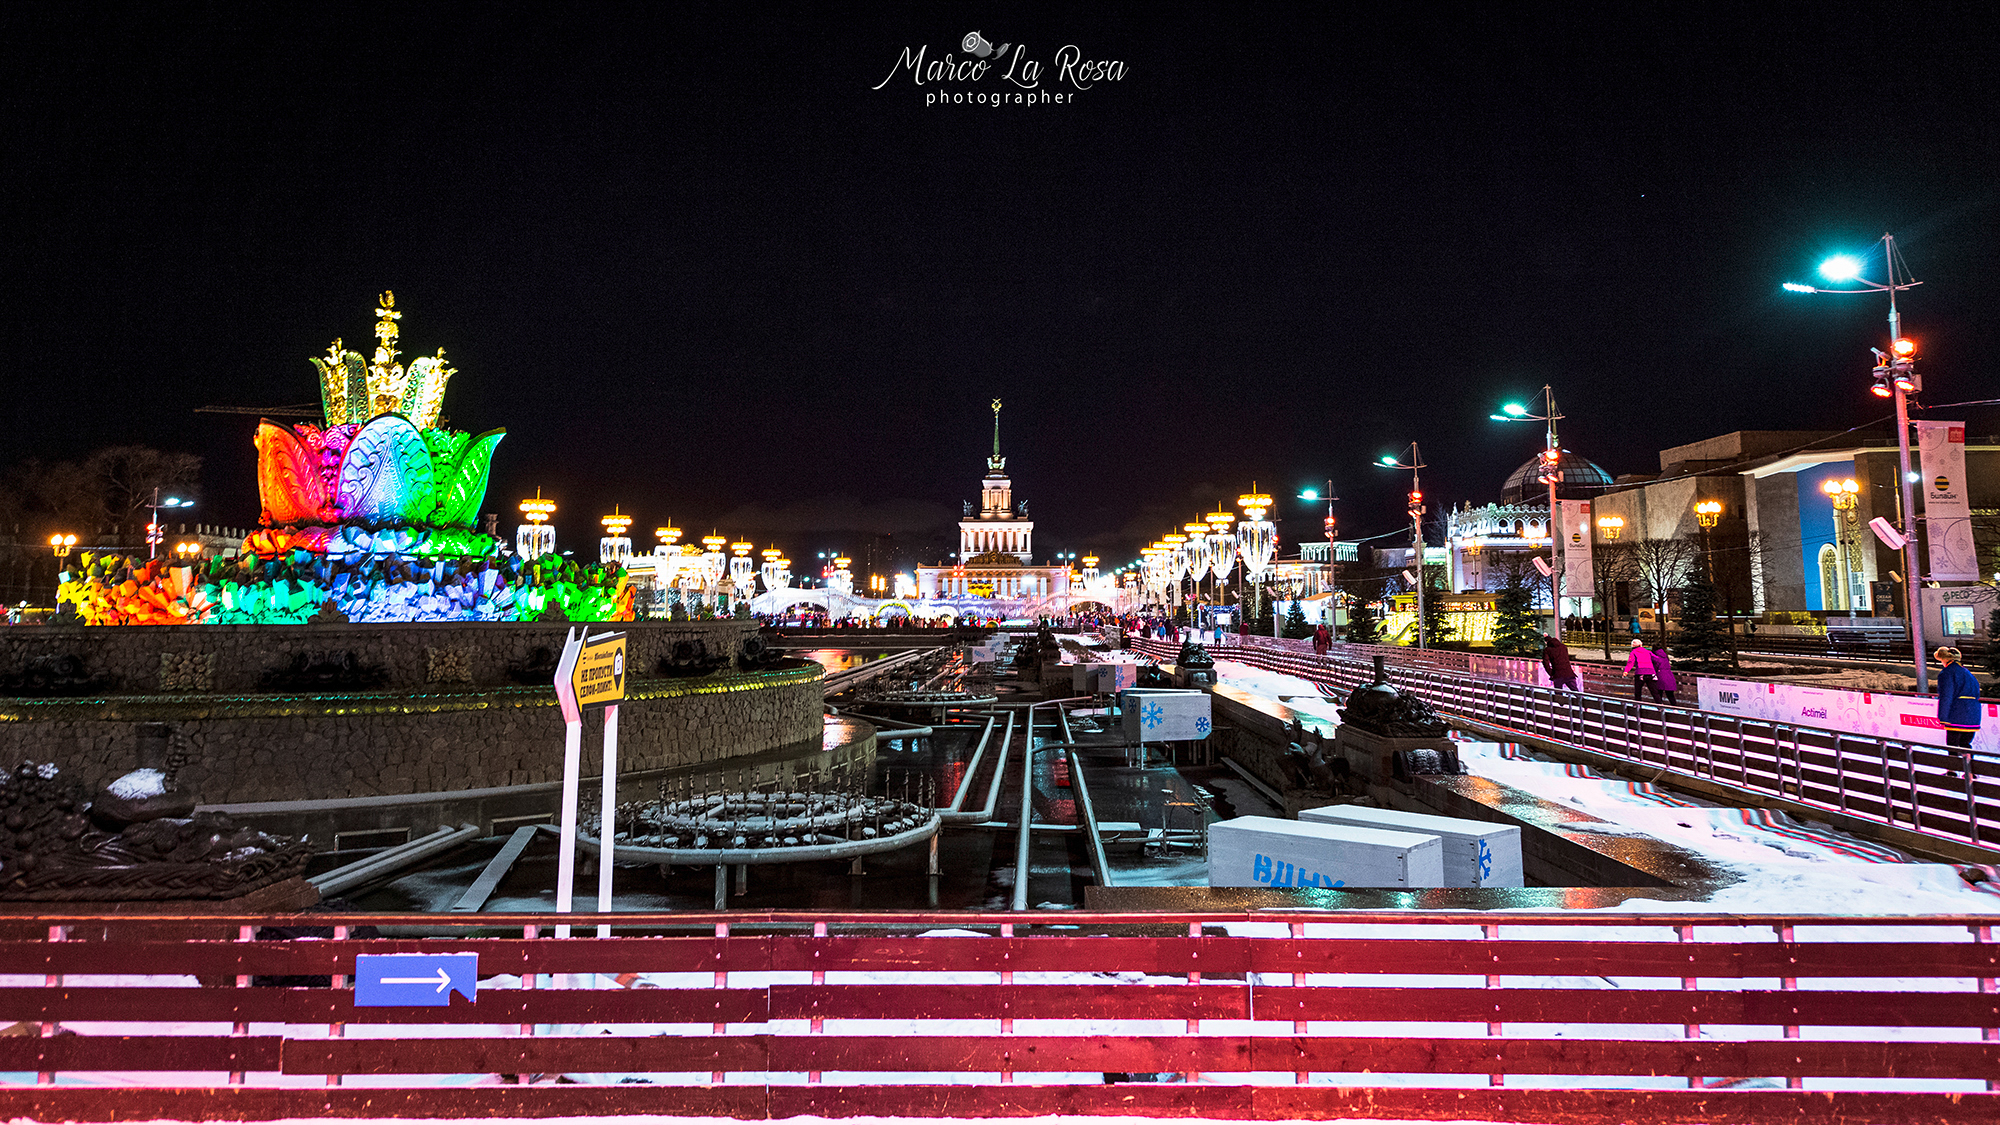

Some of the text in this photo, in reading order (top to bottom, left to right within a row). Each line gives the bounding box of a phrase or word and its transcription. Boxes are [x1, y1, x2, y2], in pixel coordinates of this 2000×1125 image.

[1719, 691, 1739, 704] МИР
[1801, 706, 1828, 719] Actimel
[1903, 716, 1942, 728] CLARINS
